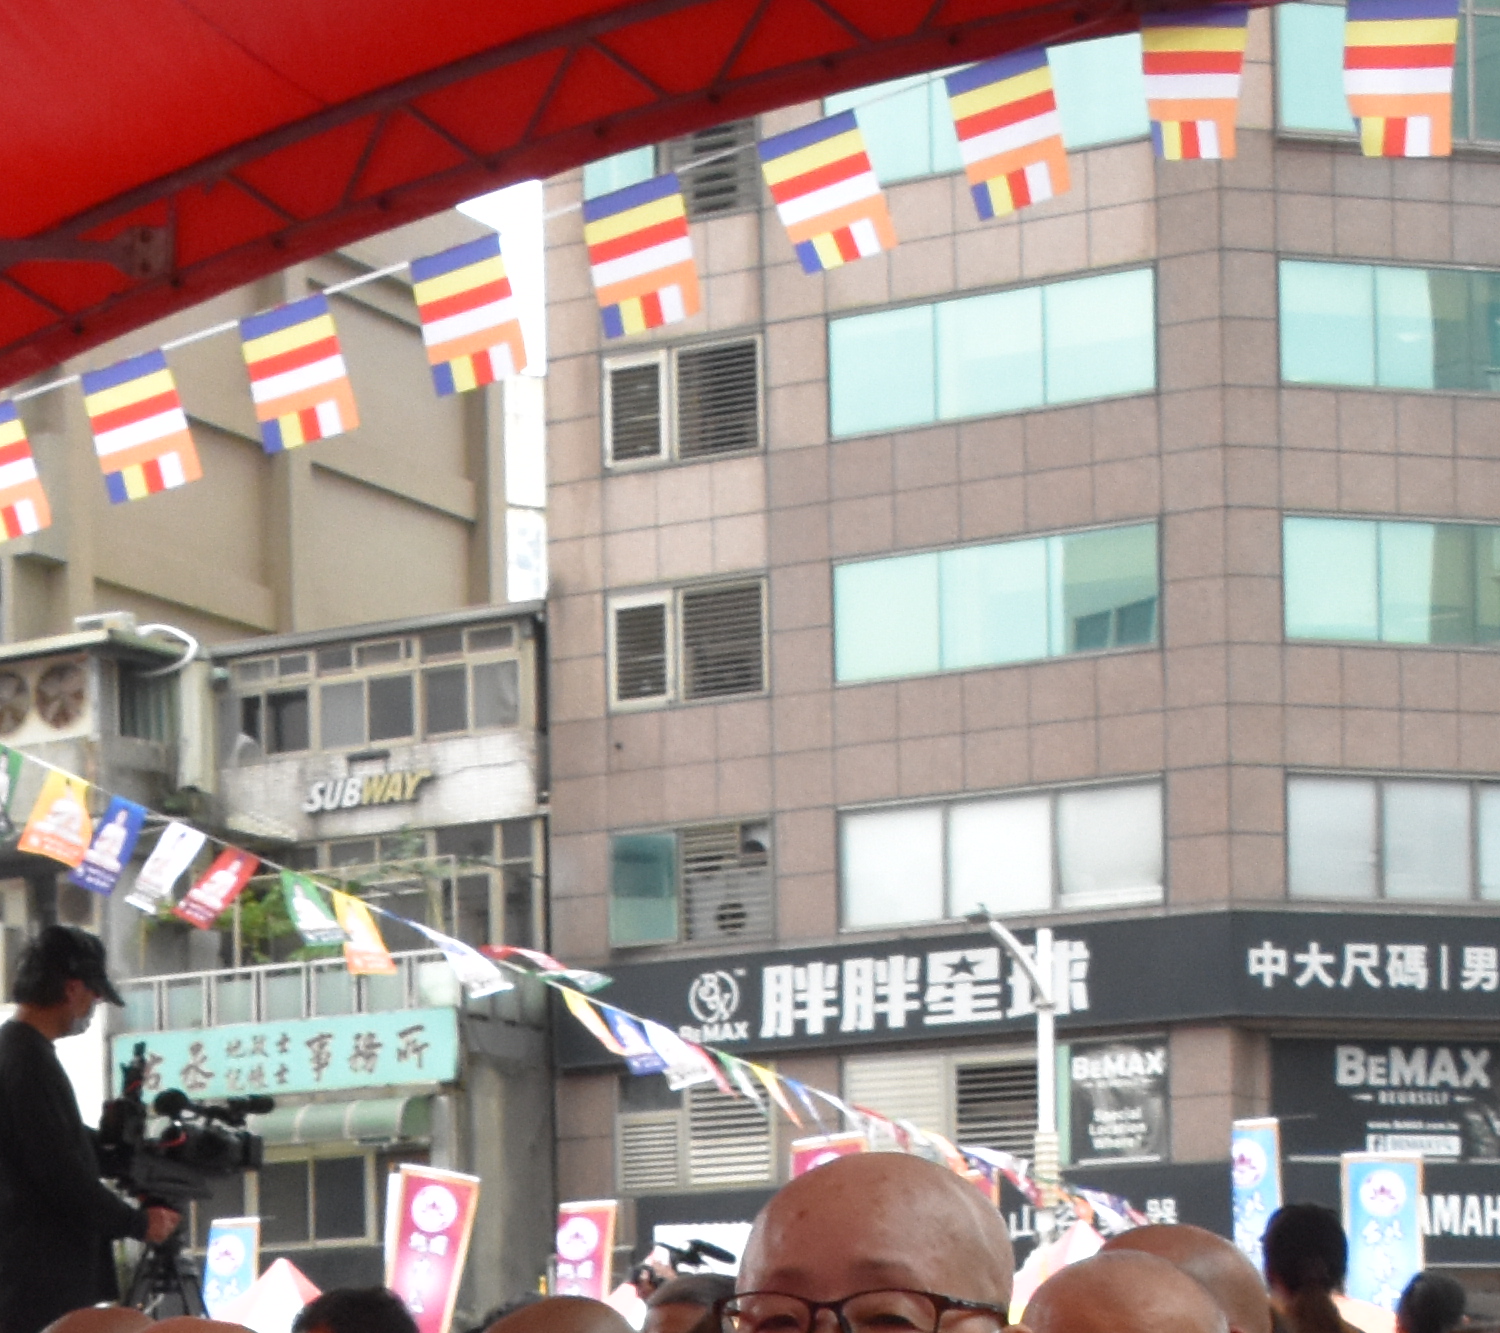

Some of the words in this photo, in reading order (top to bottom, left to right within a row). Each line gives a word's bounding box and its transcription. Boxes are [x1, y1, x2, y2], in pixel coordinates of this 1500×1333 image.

[302, 768, 432, 812] SUBWAY
[760, 940, 1090, 1039] 胖胖星球
